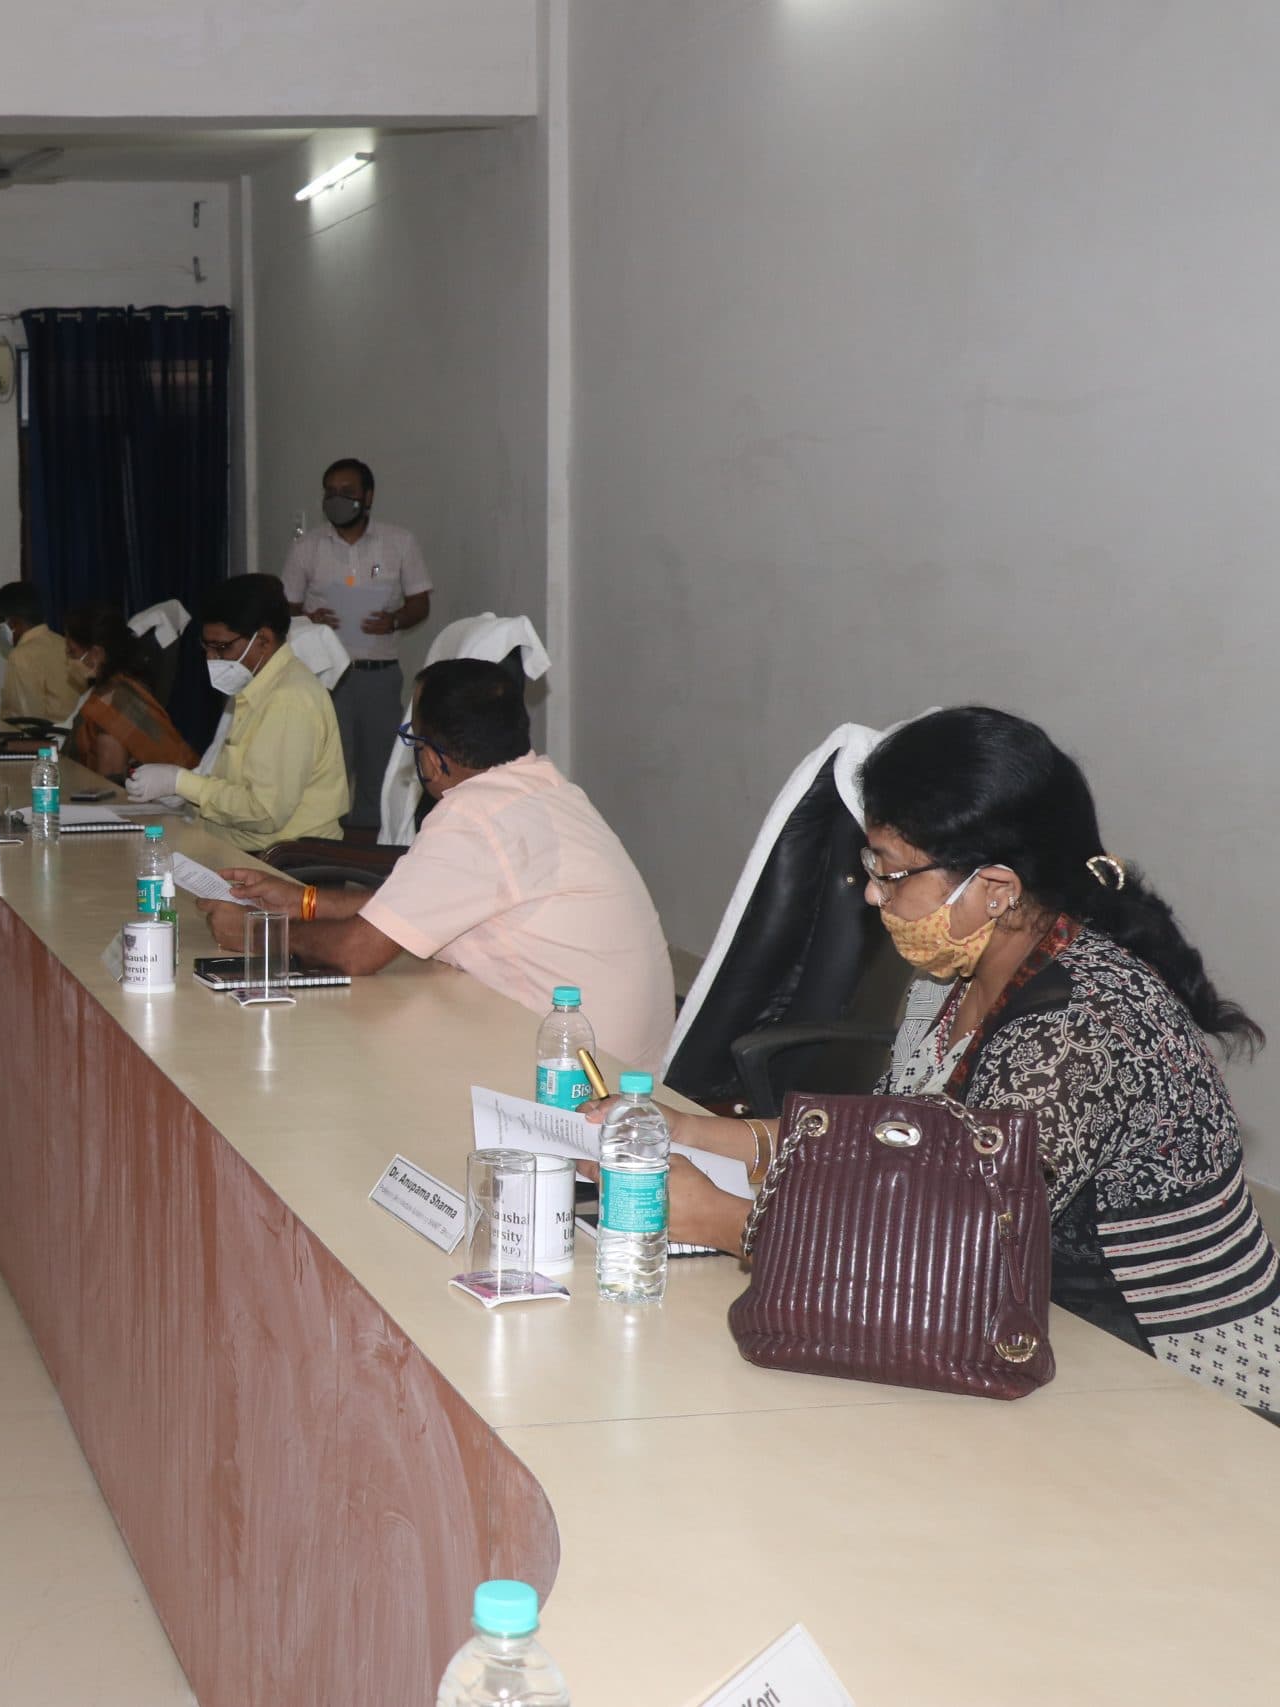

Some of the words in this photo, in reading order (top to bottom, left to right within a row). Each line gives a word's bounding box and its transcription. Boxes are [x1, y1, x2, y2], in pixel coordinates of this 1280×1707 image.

[388, 1165, 400, 1181] Dr.
[398, 1173, 431, 1201] Anupama
[429, 1193, 458, 1219] Sharma
